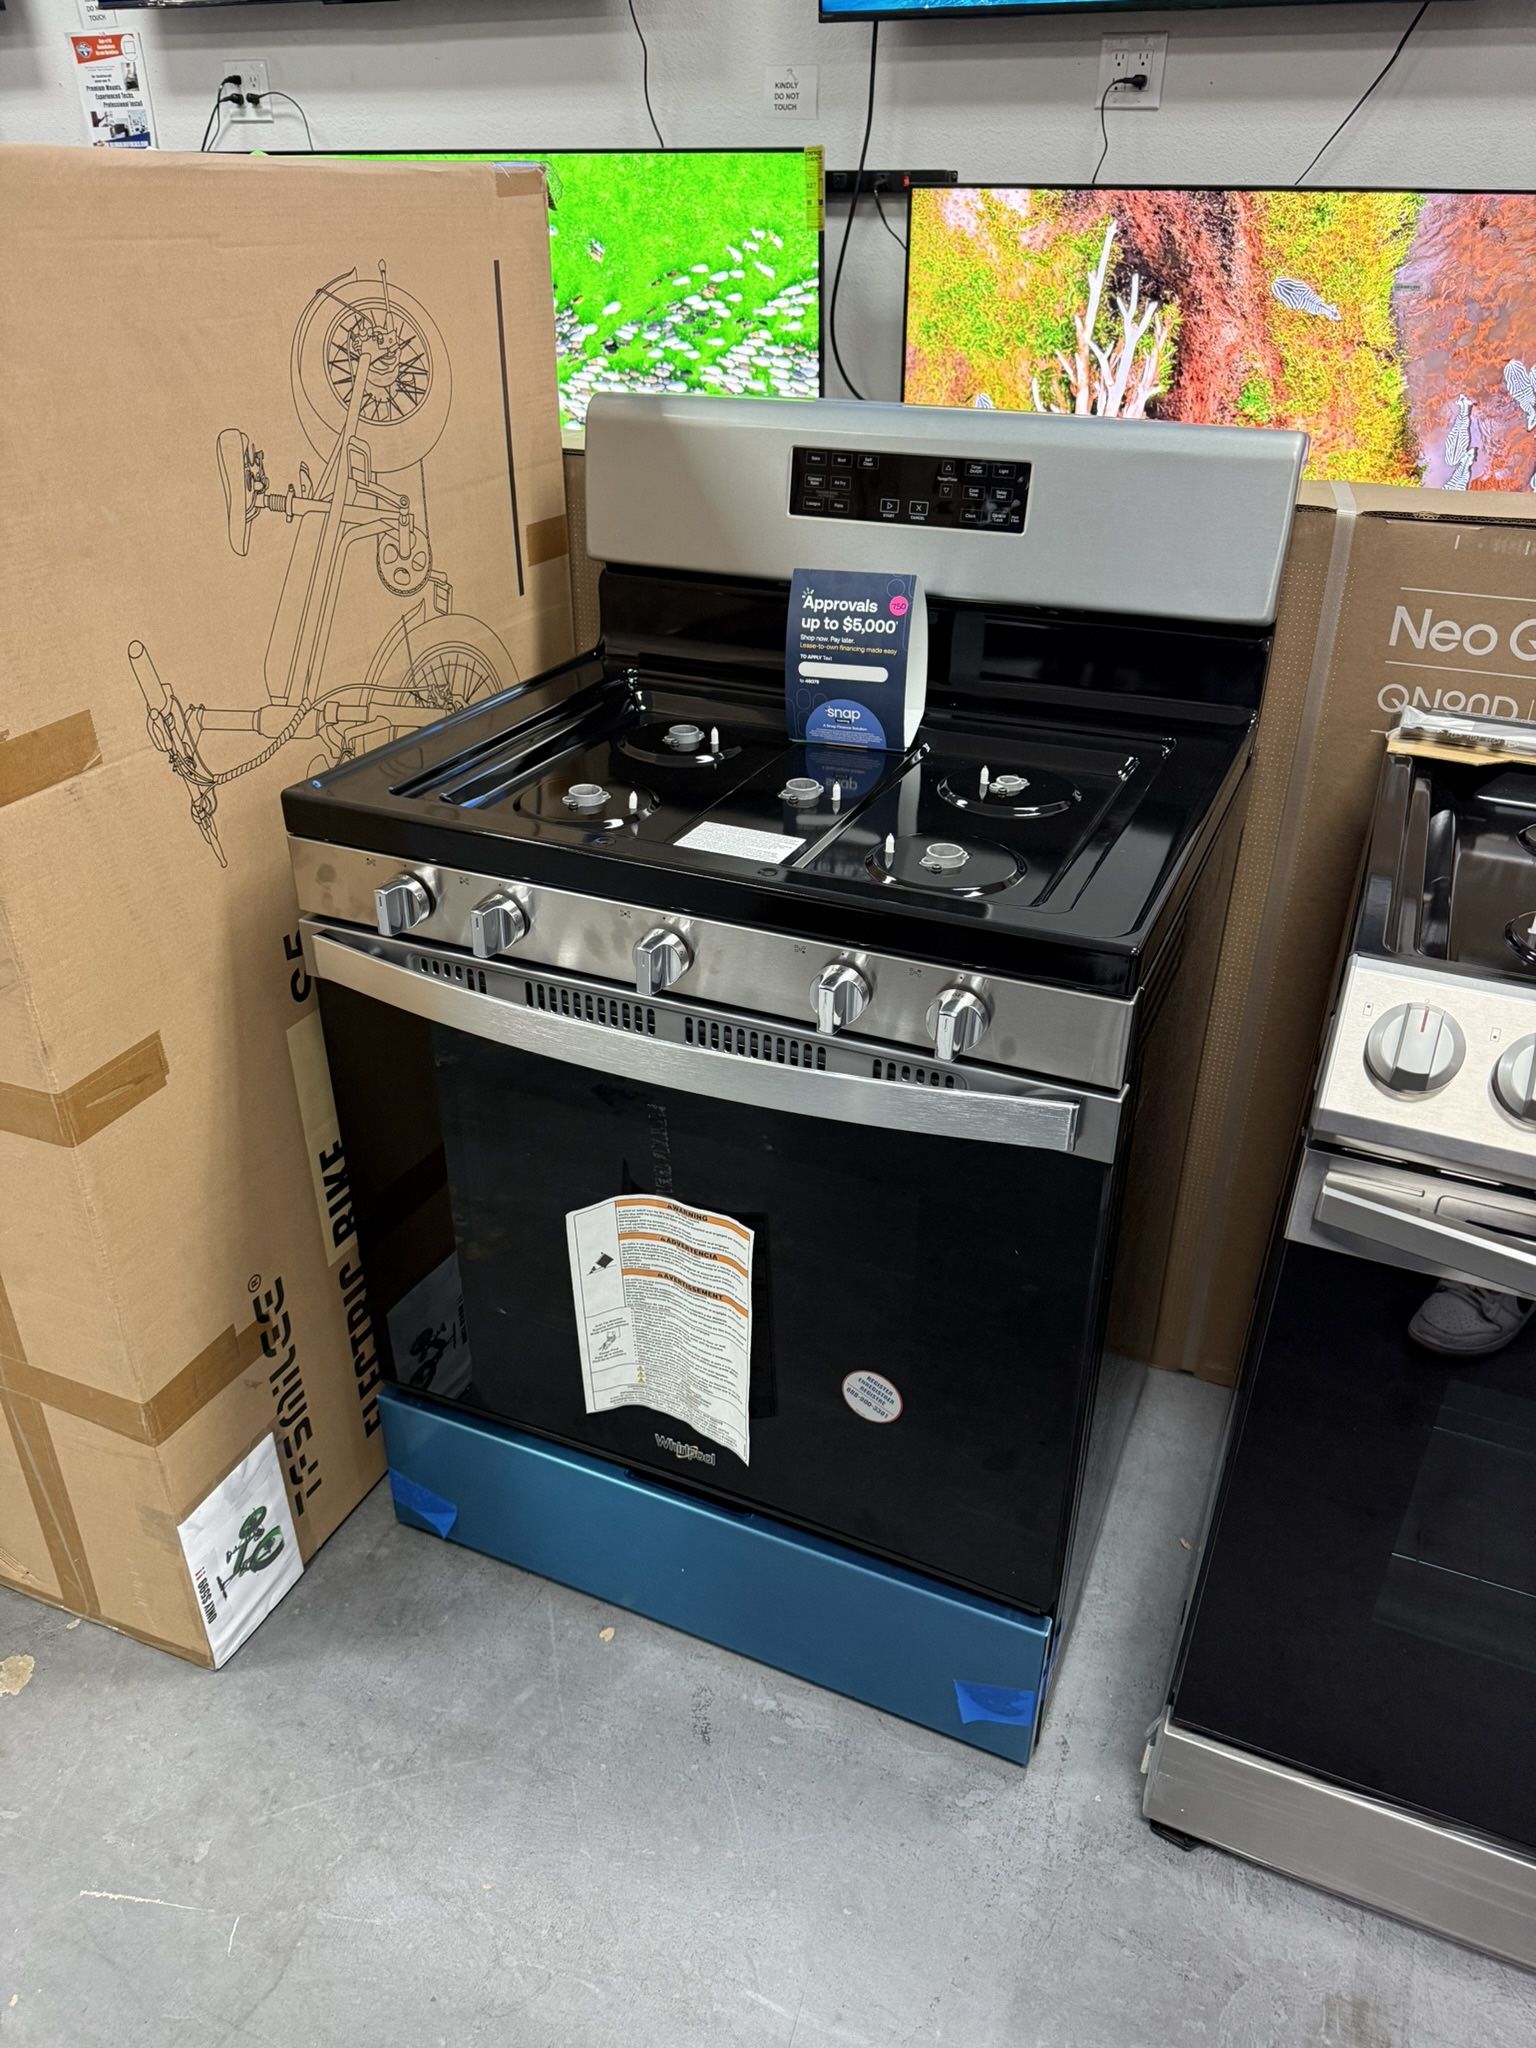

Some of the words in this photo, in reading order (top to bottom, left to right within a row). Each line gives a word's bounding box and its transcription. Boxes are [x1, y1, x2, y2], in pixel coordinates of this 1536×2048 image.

[802, 595, 878, 613] Approvals
[801, 617, 820, 632] up
[824, 616, 839, 630] to
[1388, 605, 1498, 656] Neo
[800, 634, 815, 642] Shop
[840, 645, 865, 654] financing
[826, 707, 861, 722] snap
[672, 1204, 708, 1222] WARNING
[666, 1238, 718, 1260] ADVERTENCIA
[663, 1273, 723, 1300] AVERTISSEMENT
[866, 1376, 894, 1396] REGISTER
[654, 1433, 715, 1466] Whirlpool
[198, 1577, 212, 1604] $599
[204, 1600, 217, 1624] ONLY
